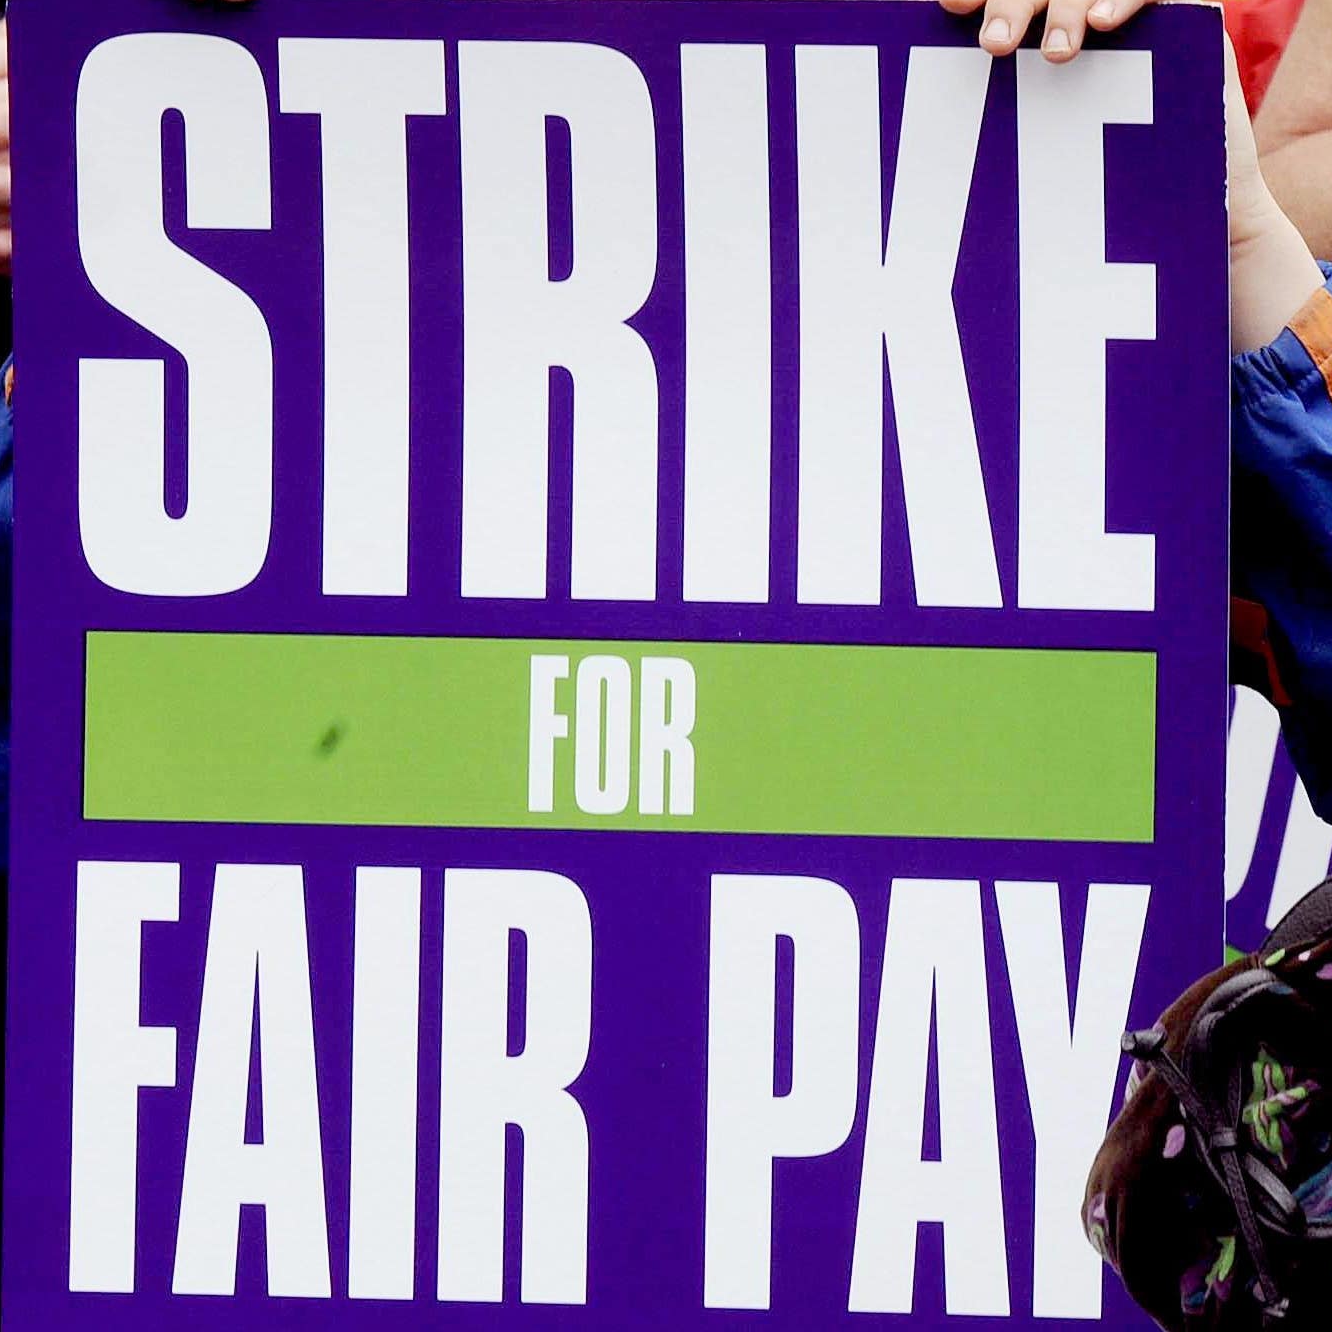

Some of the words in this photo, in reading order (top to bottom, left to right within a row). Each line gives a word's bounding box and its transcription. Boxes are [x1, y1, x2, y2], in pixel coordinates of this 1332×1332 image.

[76, 32, 1157, 611] STRIKE
[528, 654, 697, 816] FOR
[69, 860, 593, 1305] FAIR
[703, 873, 1152, 1319] PAY
